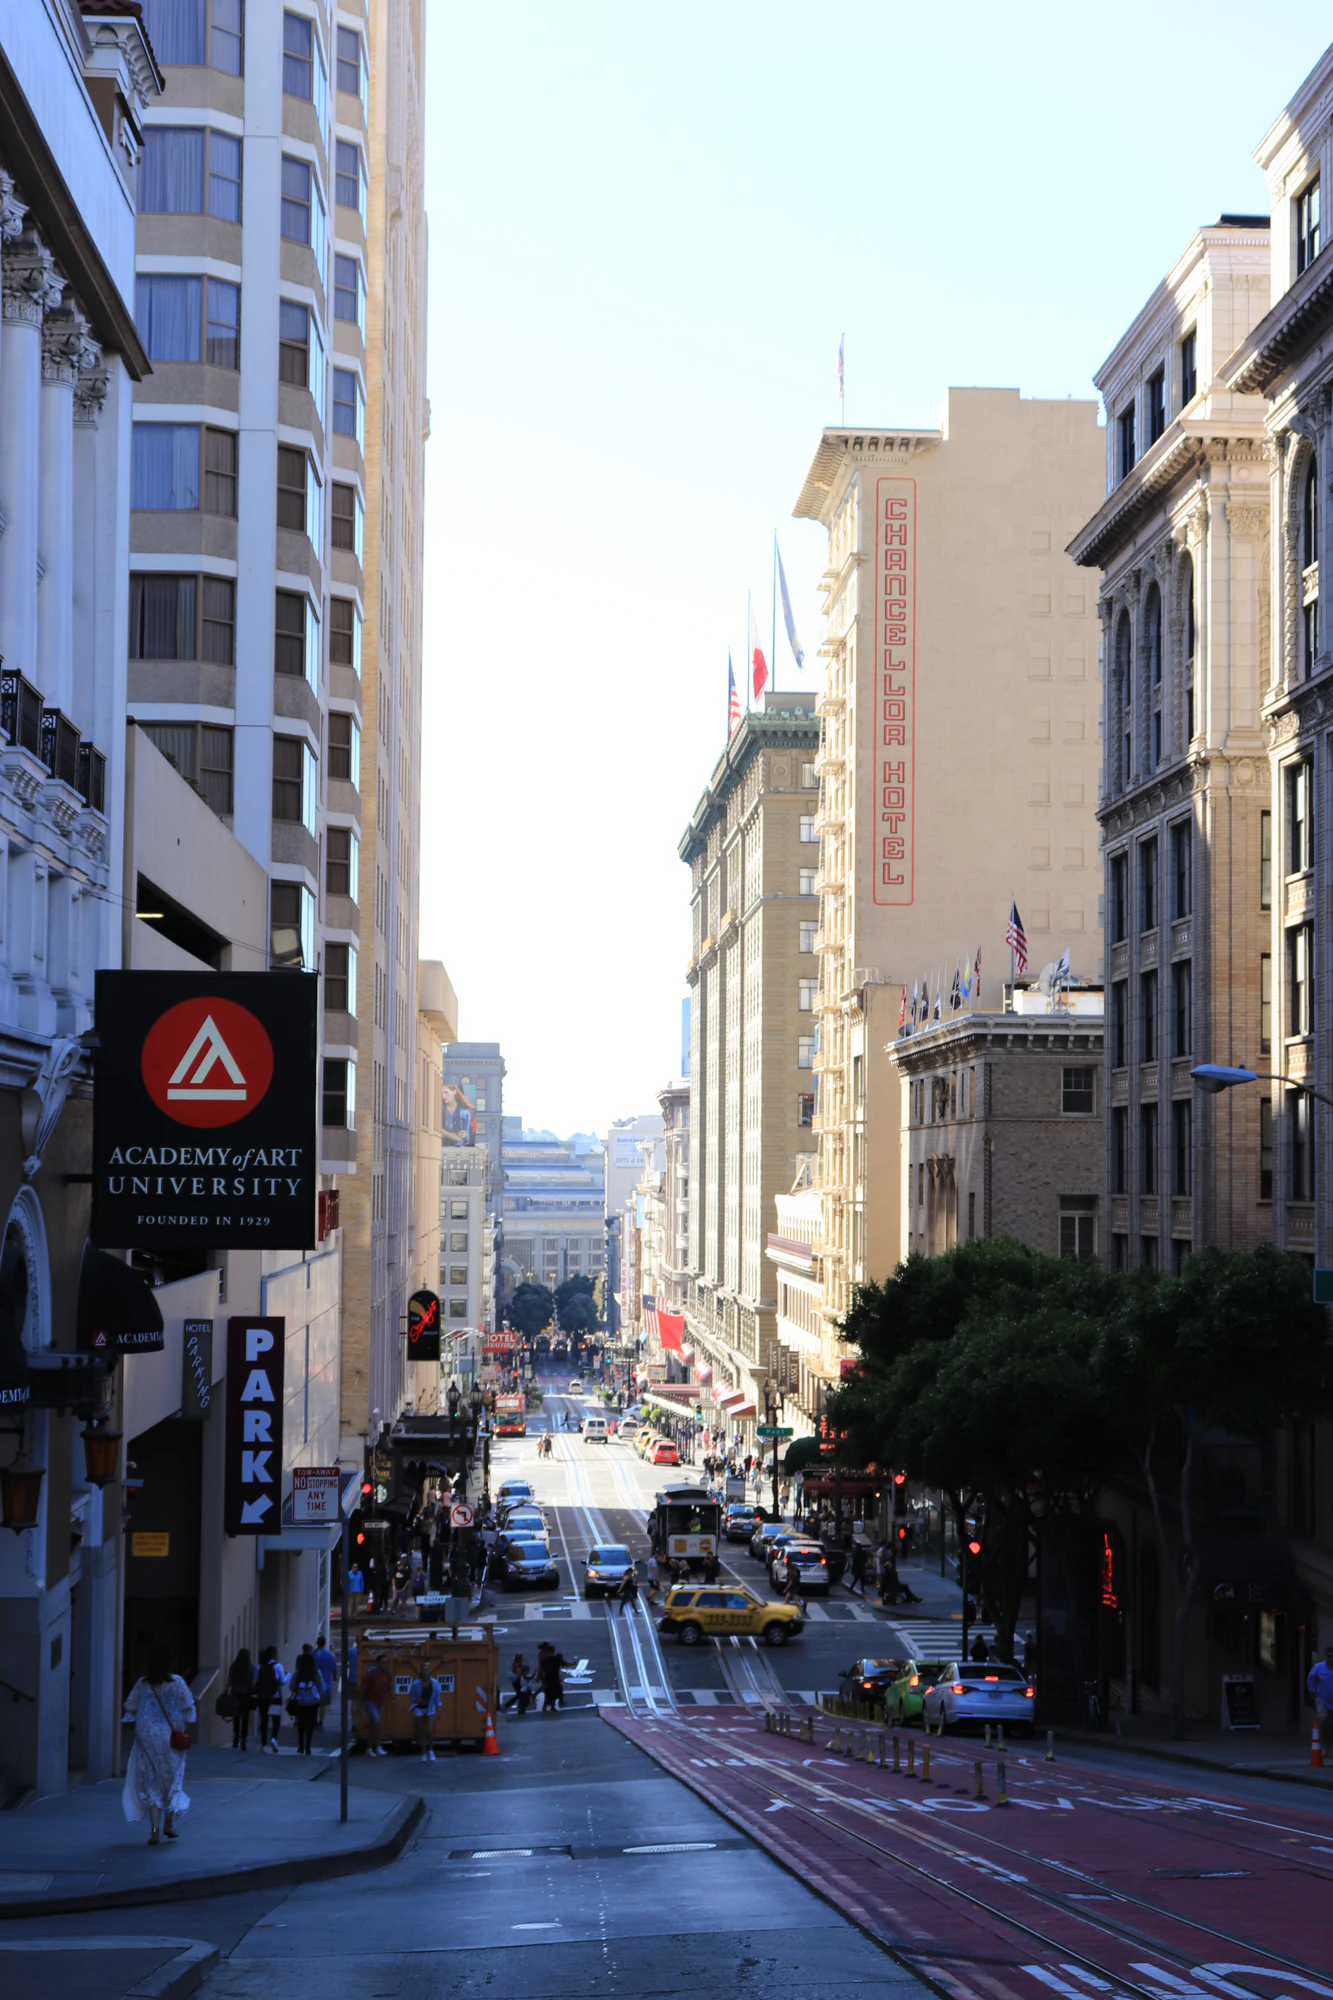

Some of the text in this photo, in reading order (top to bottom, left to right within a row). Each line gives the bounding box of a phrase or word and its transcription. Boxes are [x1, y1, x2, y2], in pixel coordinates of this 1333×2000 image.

[882, 498, 908, 885] CHANCELLOR HOTEL
[108, 1147, 303, 1171] ACADEMY of ART
[108, 1176, 302, 1196] UNIVERSITY
[137, 1215, 271, 1227] FOUNDED IN 1929
[185, 1324, 211, 1332] HOTEL
[116, 1331, 159, 1344] ACADEMY
[186, 1336, 210, 1409] PARKING
[790, 1363, 798, 1385] DSW
[240, 1328, 275, 1484] PARK
[294, 1477, 338, 1489] NO STOPPING
[307, 1491, 325, 1500] ANY
[307, 1501, 327, 1511] TIME
[395, 1676, 412, 1685] RENT
[437, 1675, 454, 1684] RENT
[398, 1685, 409, 1693] ME
[440, 1684, 451, 1692] ME
